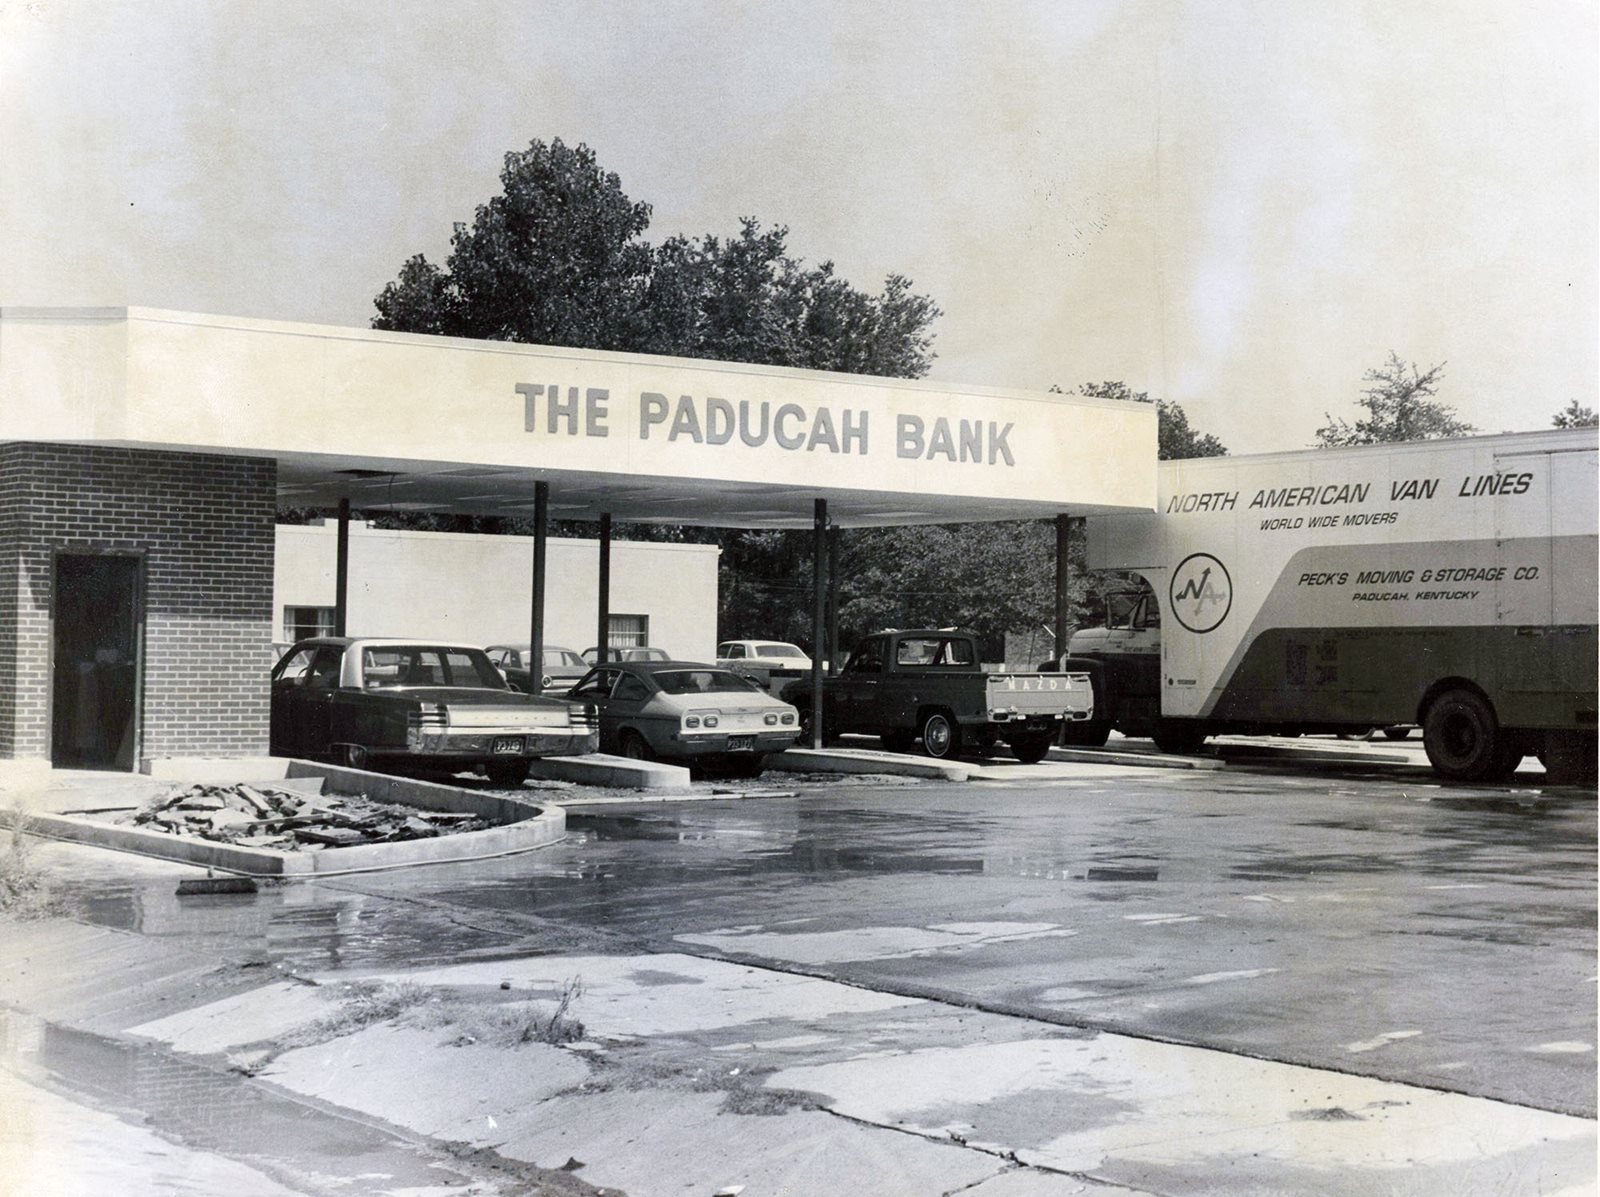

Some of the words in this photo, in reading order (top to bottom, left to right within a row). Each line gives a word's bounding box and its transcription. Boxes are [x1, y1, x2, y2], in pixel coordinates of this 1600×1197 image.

[515, 382, 610, 437] THE
[639, 391, 870, 455] PADUCAH
[896, 413, 1016, 467] BANK
[1166, 491, 1240, 514] NORTH
[1249, 483, 1371, 509] AMERICAN
[1390, 478, 1440, 501] VAN
[1458, 472, 1534, 498] LINES
[1260, 517, 1304, 531] WORLD
[1307, 515, 1340, 529] WIDE
[1342, 512, 1399, 527] MOVERS
[1298, 572, 1350, 586] PECK'S
[1356, 570, 1415, 585] MOVING
[1420, 569, 1433, 583] &
[1434, 567, 1507, 582] STORAGE
[1513, 566, 1540, 581] CO.
[1414, 591, 1480, 601] KENTUCKY
[1008, 679, 1072, 691] MAZDA
